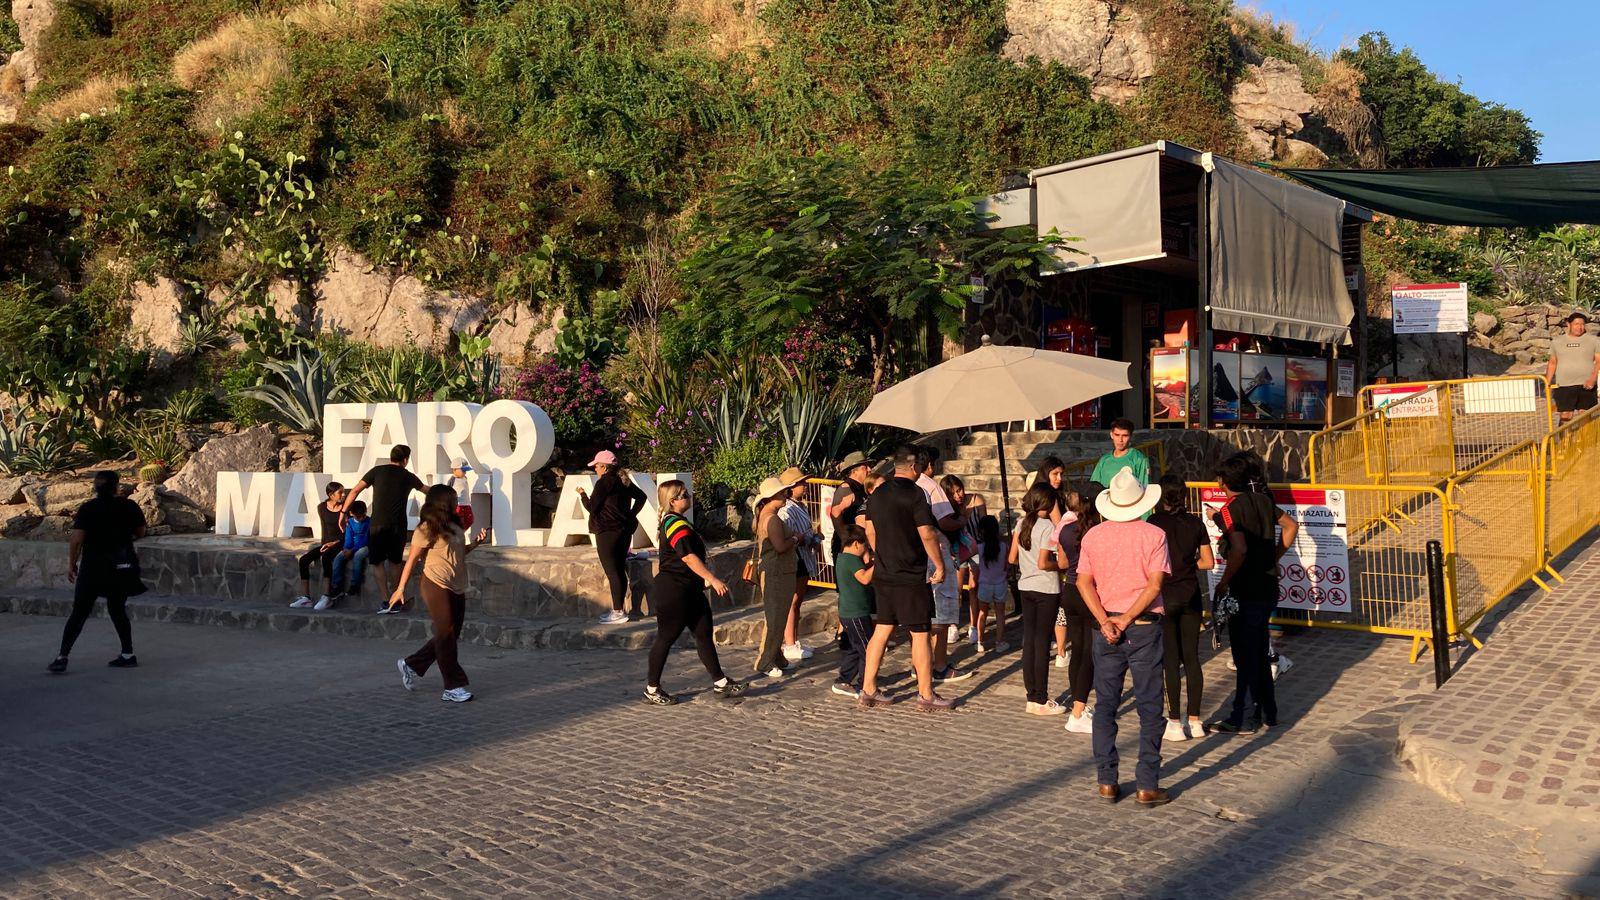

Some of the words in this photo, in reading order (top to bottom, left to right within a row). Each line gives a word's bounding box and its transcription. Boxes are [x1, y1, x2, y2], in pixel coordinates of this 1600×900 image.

[1403, 291, 1422, 299] ALTO
[1390, 397, 1434, 405] ERADA
[1391, 405, 1434, 414] ENTRANCE
[323, 399, 550, 475] FARO
[215, 471, 690, 548] MALAN
[1287, 509, 1297, 517] DE
